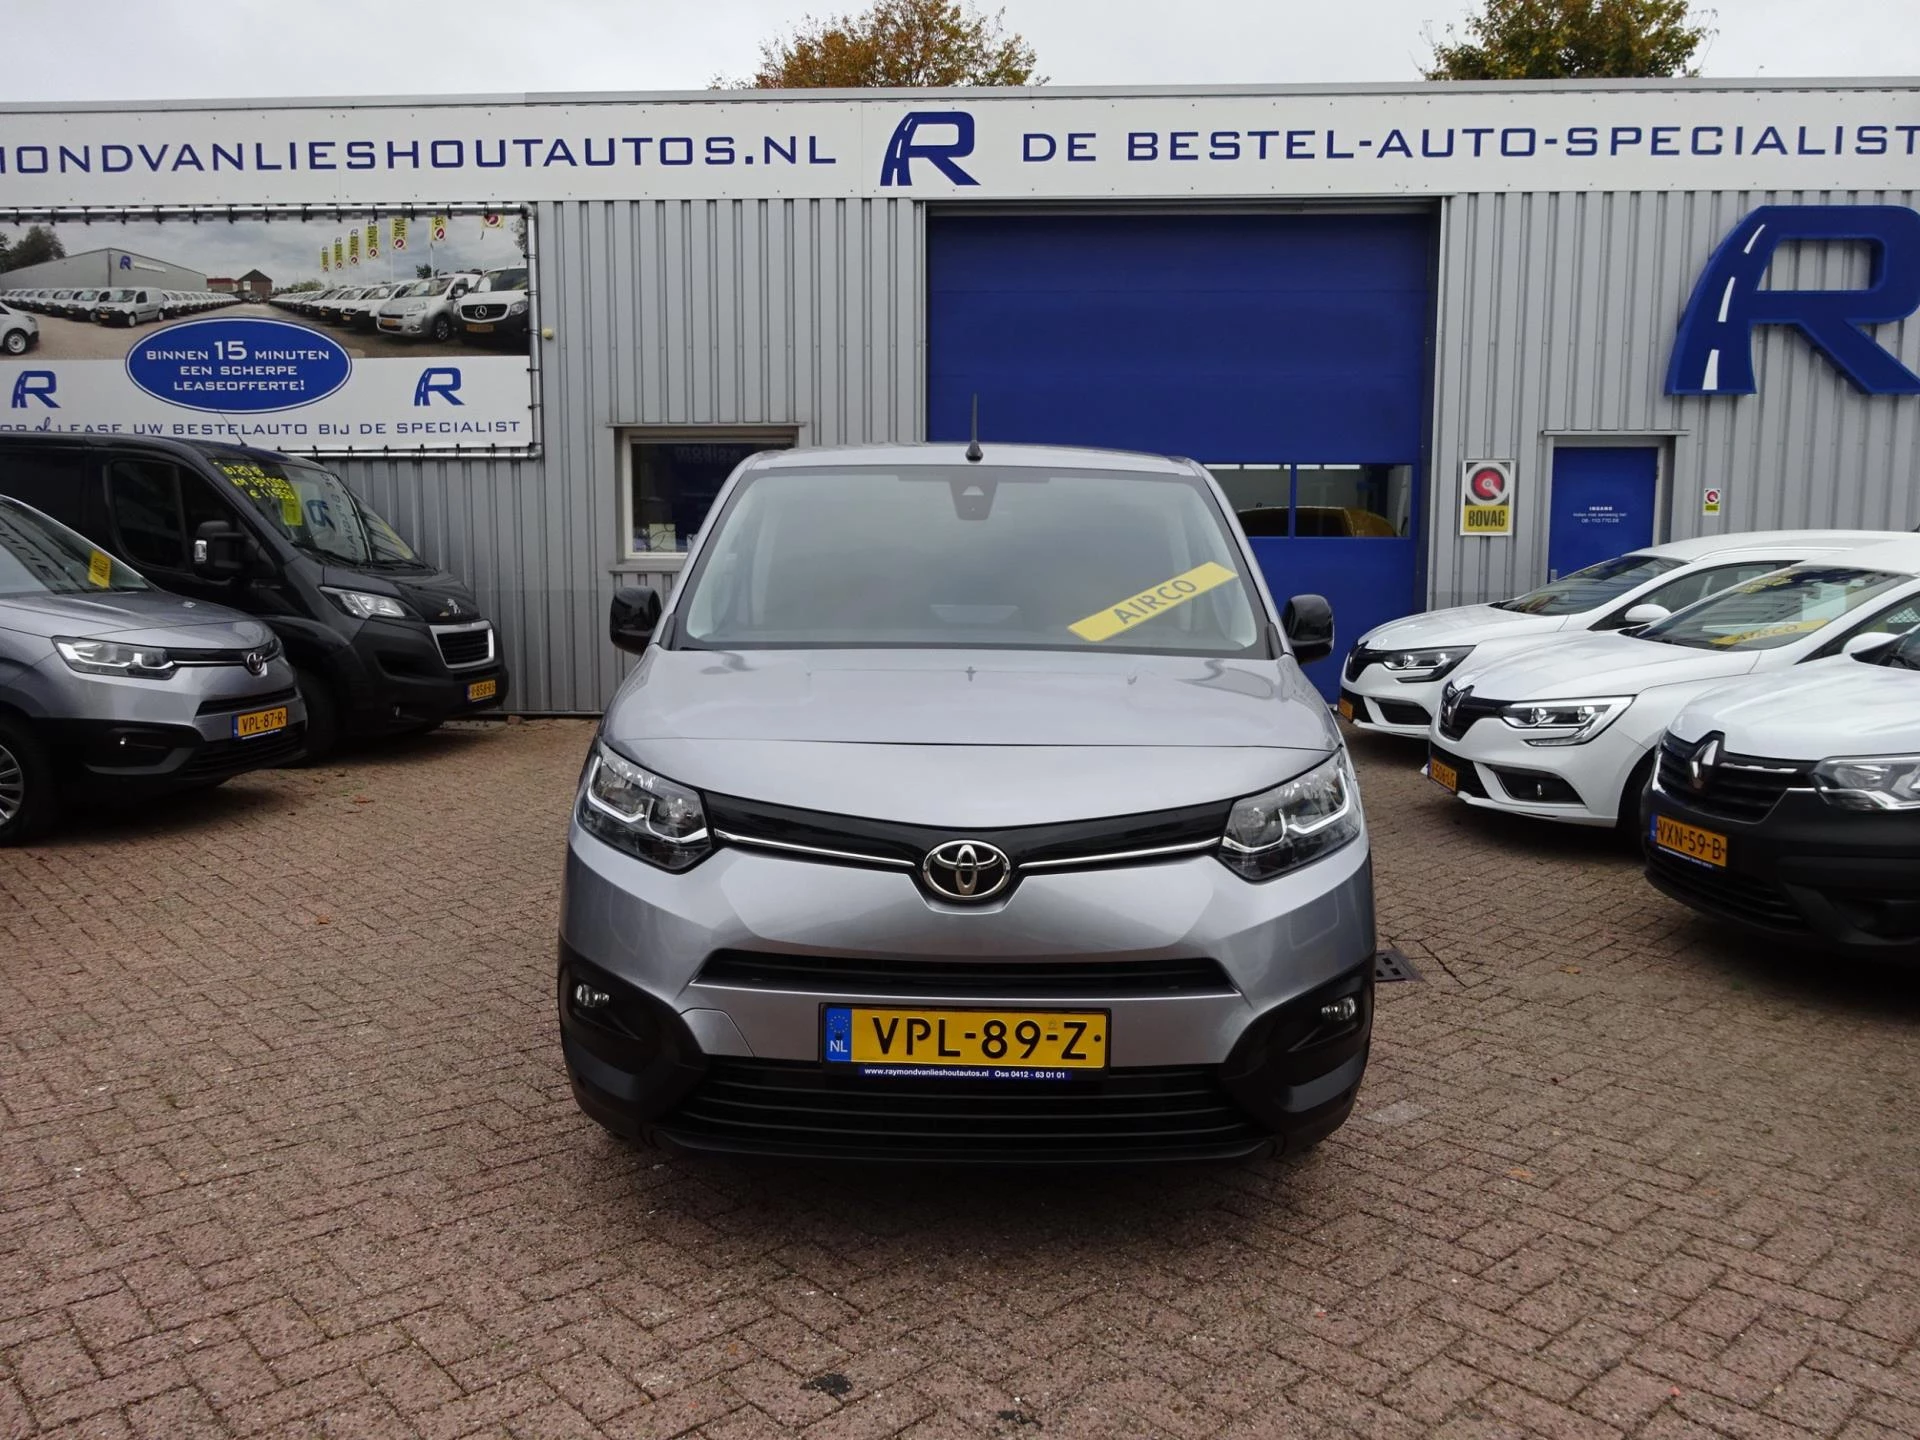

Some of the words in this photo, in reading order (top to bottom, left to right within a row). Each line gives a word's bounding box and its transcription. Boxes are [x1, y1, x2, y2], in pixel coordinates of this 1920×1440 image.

[1023, 133, 1096, 162] DE
[1128, 126, 1920, 161] BESTEL-AUTO-SPECIALIST
[0, 136, 836, 174] ONDVANLIESHOUTAUTOS.NL
[146, 350, 209, 360] BINNEN
[214, 341, 248, 360] 15
[254, 350, 329, 360] MINUTEN
[180, 366, 213, 375] EEN
[220, 366, 298, 375] SCHERPE
[173, 380, 305, 391] LEASEOFFERTE!
[133, 424, 164, 435] UW
[173, 423, 308, 435] BESTELAUTO
[318, 423, 350, 435] BIJ
[359, 423, 387, 434] DE
[396, 421, 521, 434] SPECIALIST
[1468, 510, 1505, 527] BOVAG
[1112, 579, 1197, 624] AIRCO
[242, 711, 284, 732] VPL-87-R
[1659, 820, 1722, 860] VXN-59-B
[829, 1040, 848, 1053] NL
[872, 1017, 1088, 1060] VPL-89-Z
[864, 1068, 989, 1079] www.raymondvanlieshoutautos.nl
[994, 1070, 1010, 1078] Oss
[1010, 1070, 1029, 1078] 0412
[1056, 1071, 1066, 1079] 01
